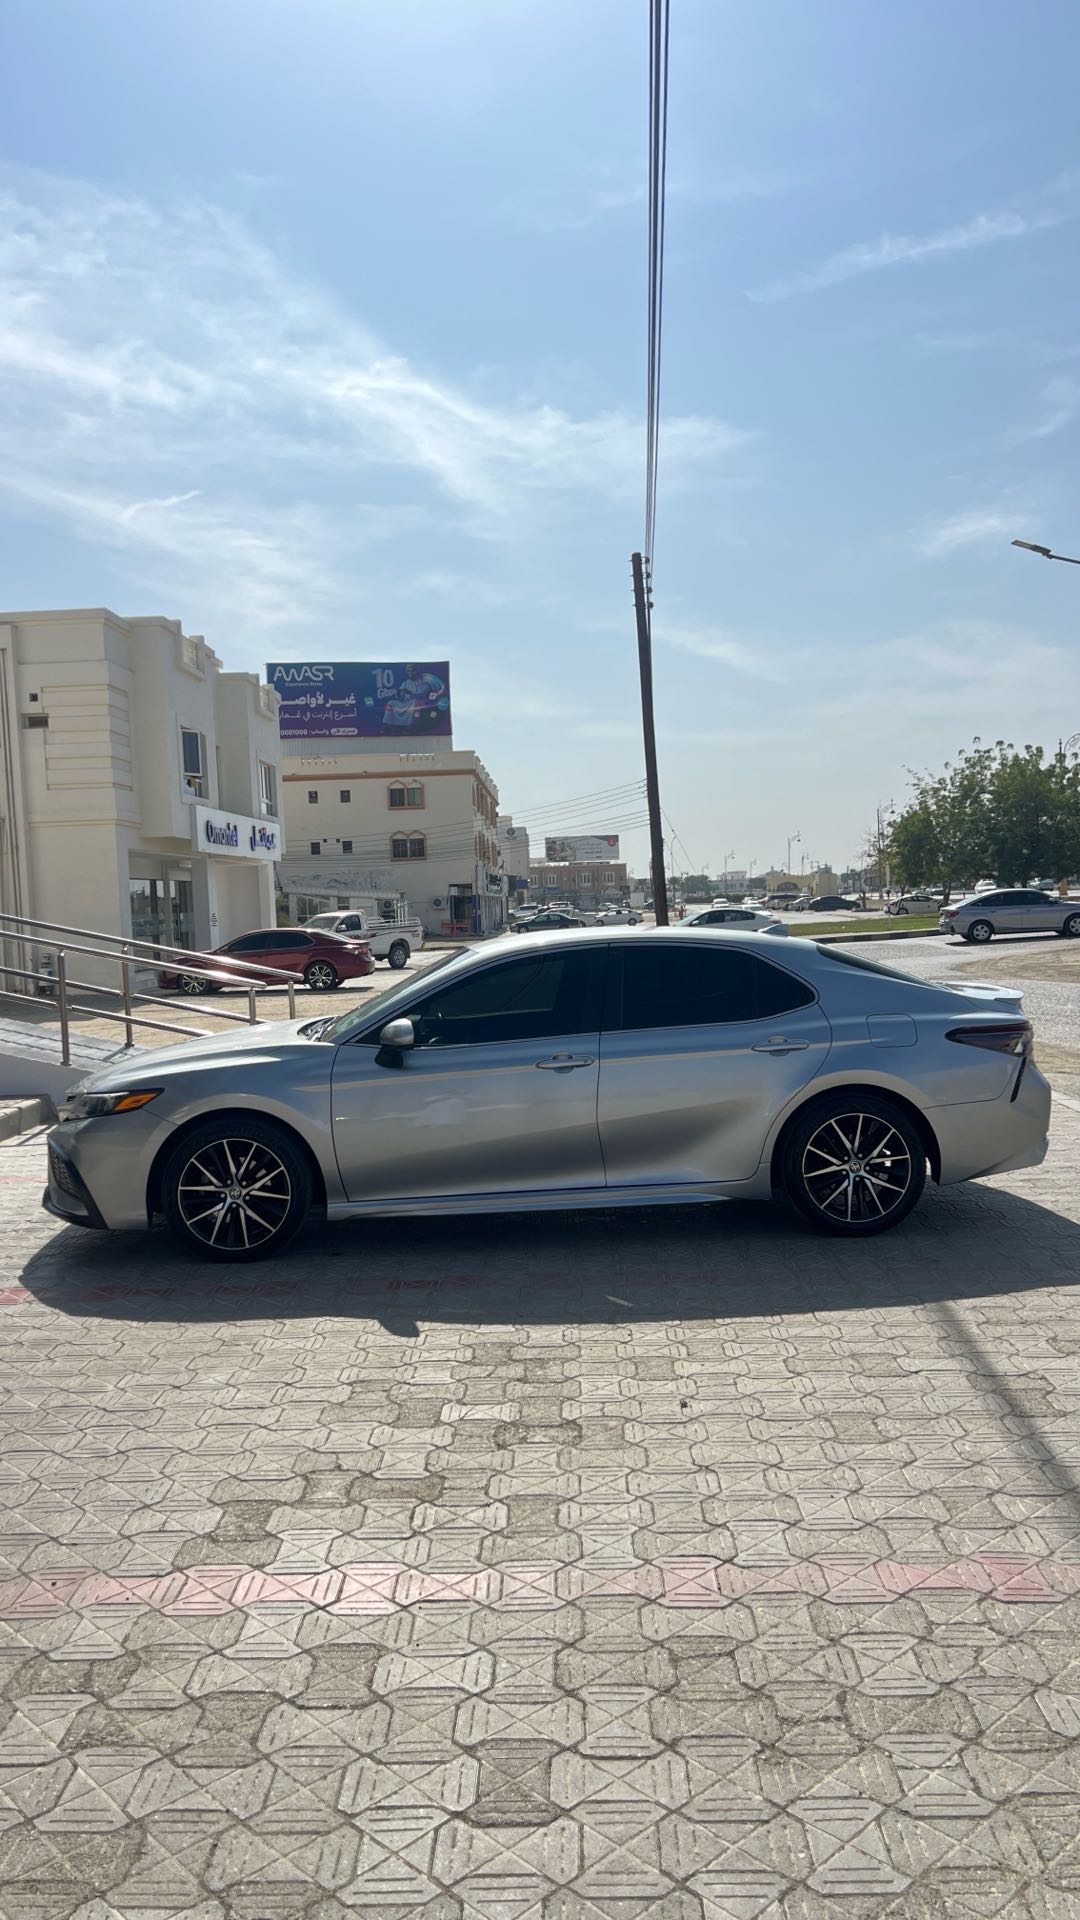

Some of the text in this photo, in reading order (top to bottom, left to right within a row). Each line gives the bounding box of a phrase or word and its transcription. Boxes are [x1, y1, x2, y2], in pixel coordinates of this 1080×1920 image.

[273, 665, 335, 682] AWASR
[371, 668, 395, 688] 10
[280, 691, 324, 707] لأواص
[302, 710, 311, 722] في
[280, 728, 308, 736] 0001000
[205, 819, 239, 847] Omantel
